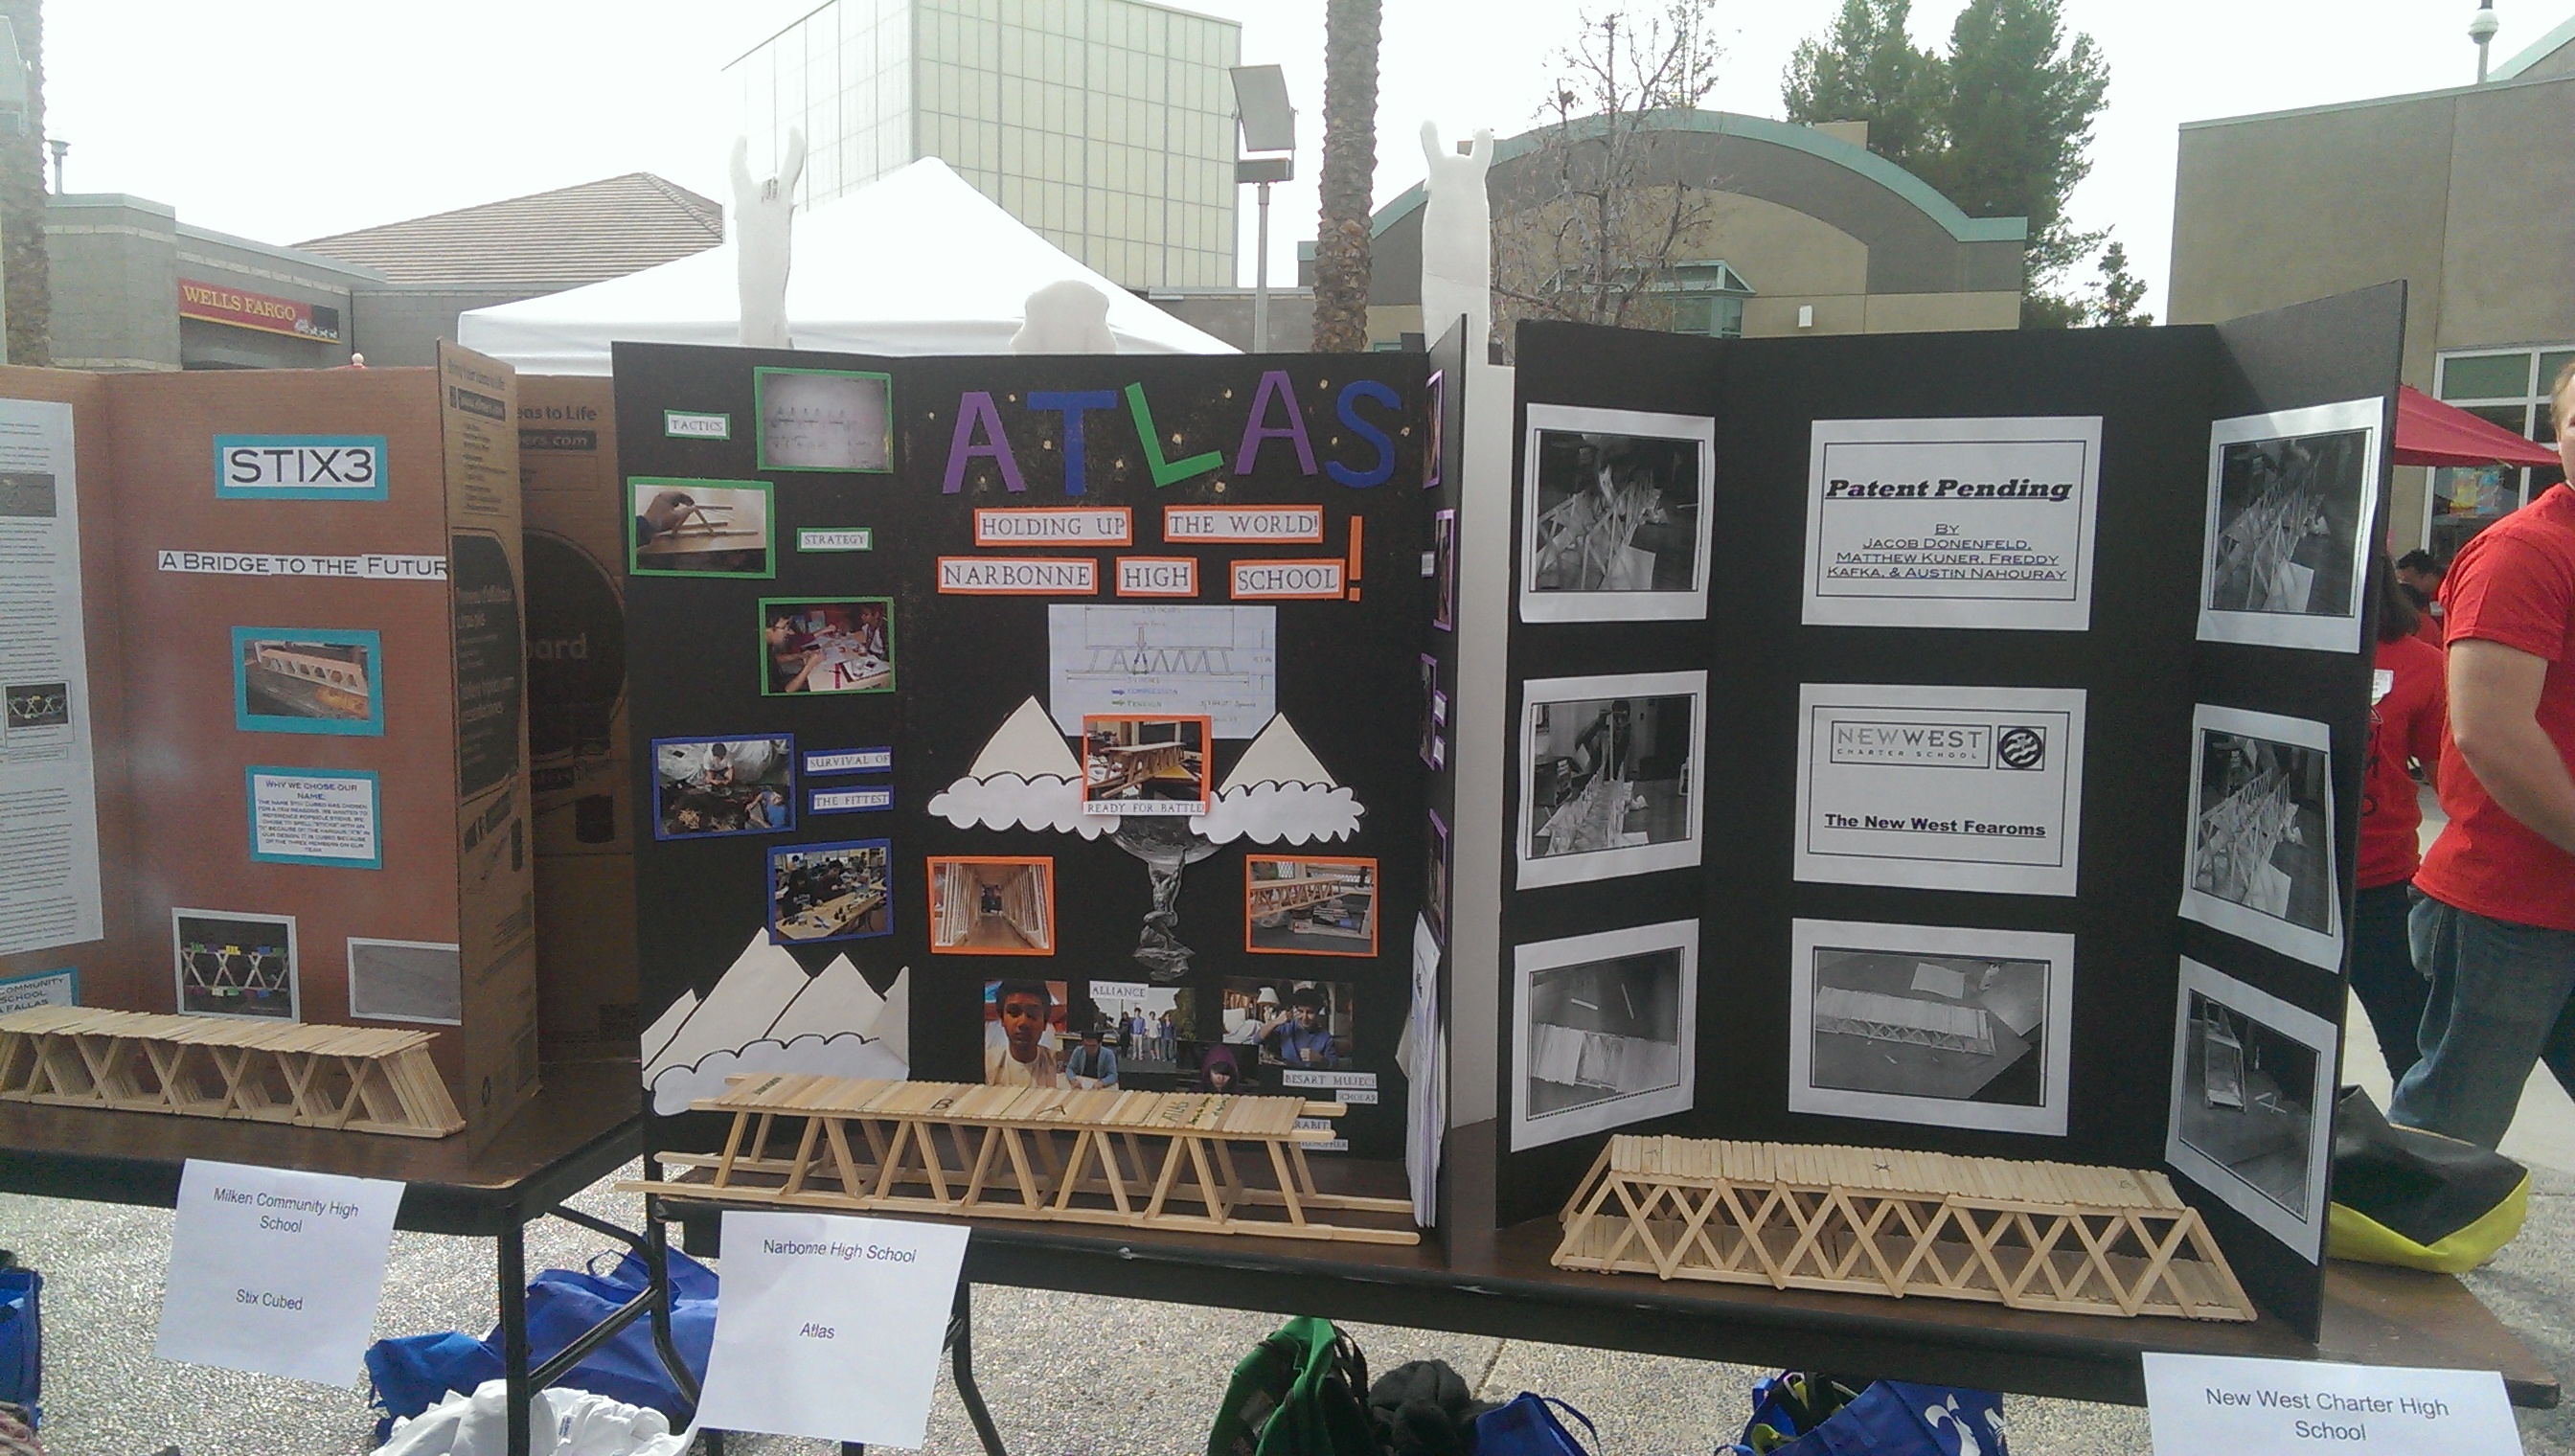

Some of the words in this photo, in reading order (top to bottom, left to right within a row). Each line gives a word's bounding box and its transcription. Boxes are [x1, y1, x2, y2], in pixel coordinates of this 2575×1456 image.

[181, 286, 241, 312] WELLS
[243, 297, 296, 321] FARGO
[672, 419, 723, 431] TACTICS
[942, 370, 1401, 496] ATLAS
[230, 448, 373, 484] STIX3
[1826, 479, 1929, 498] Patent
[1934, 479, 2073, 502] Pending
[982, 517, 1082, 535] HOLDING
[1096, 517, 1126, 535] UP
[1170, 515, 1215, 534] THE
[1228, 515, 1318, 534] WORLD!
[1934, 524, 1960, 535] BY
[805, 535, 864, 545] STRATEGY
[1863, 538, 1919, 550] JACOB
[161, 552, 177, 570] A
[184, 553, 269, 573] BRIDGE
[275, 558, 306, 574] TO
[312, 559, 357, 575] THE
[1836, 553, 1918, 564] MATTHEW
[1990, 554, 2060, 565] FREDDY
[944, 565, 1091, 586] NARBONNE
[1125, 566, 1190, 588] HIGH
[1238, 568, 1337, 591] SCHOOL
[1889, 567, 1902, 578] &
[1906, 567, 1968, 579] AUSTIN
[810, 756, 869, 768] SURVIVAL
[876, 754, 890, 763] OF
[1916, 751, 1977, 760] SCHOOL
[814, 796, 838, 807] THE
[845, 794, 889, 805] FITTEST
[1087, 803, 1126, 812] READY
[1133, 803, 1153, 812] FOR
[1825, 813, 1858, 828] The
[1864, 815, 1905, 830] New
[1910, 817, 1958, 832] West
[1965, 821, 2046, 836] Fearoms
[1092, 985, 1146, 997] ALLIANCE
[7, 999, 49, 1012] FALLAS
[1286, 1074, 1326, 1084] BESART
[213, 1188, 253, 1205] Milken
[256, 1192, 327, 1216] Community
[329, 1201, 359, 1219] High
[260, 1215, 303, 1233] School
[763, 1240, 827, 1255] Narbonne
[830, 1241, 862, 1261] High
[866, 1244, 918, 1263] School
[236, 1288, 259, 1305] Stix
[262, 1292, 303, 1310] Cubed
[799, 1322, 835, 1339] Atlas
[2206, 1388, 2252, 1407] New
[2256, 1390, 2311, 1410] West
[2316, 1392, 2394, 1414] Charter
[2399, 1399, 2450, 1419] High
[2295, 1420, 2367, 1442] School
